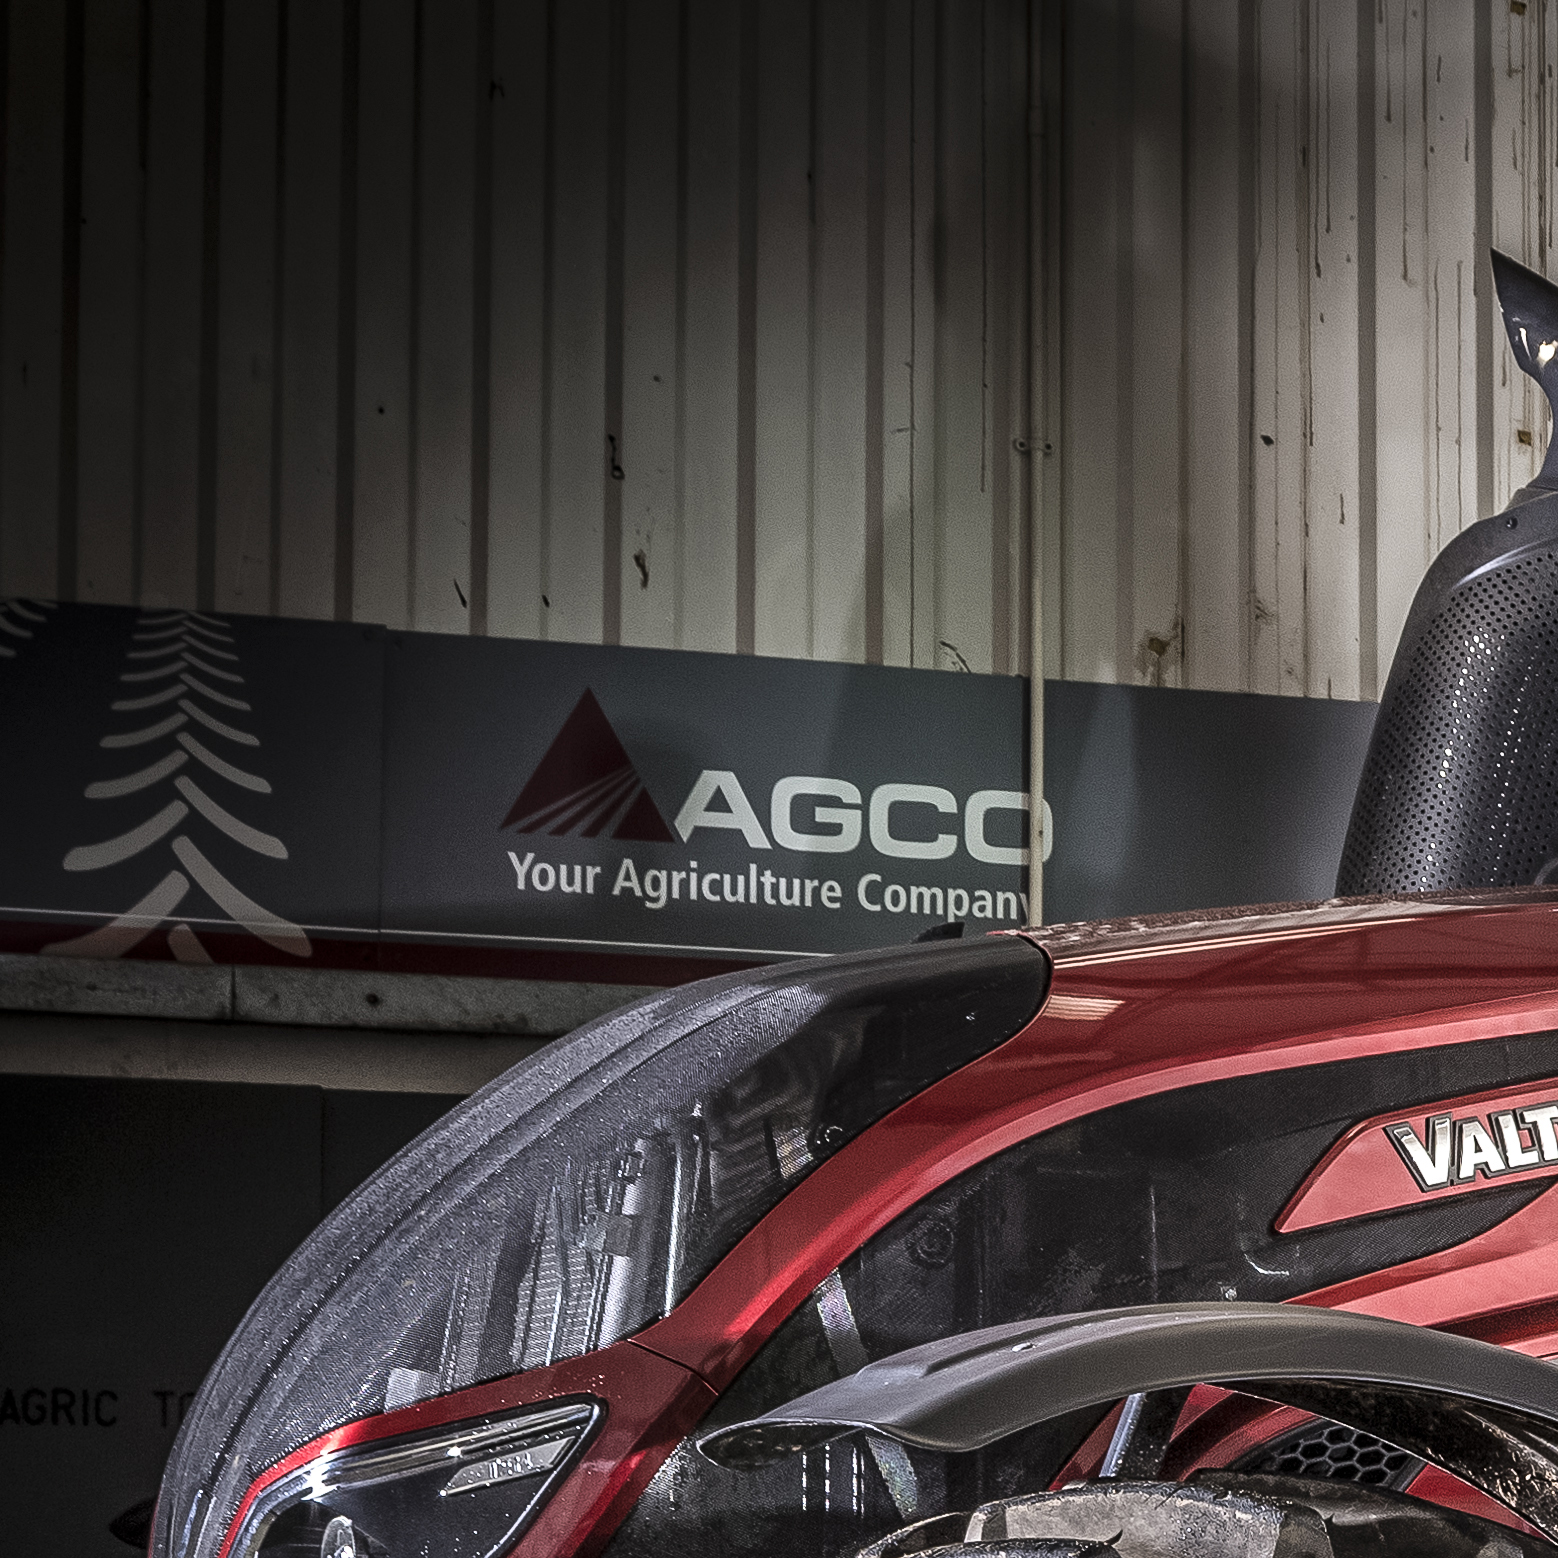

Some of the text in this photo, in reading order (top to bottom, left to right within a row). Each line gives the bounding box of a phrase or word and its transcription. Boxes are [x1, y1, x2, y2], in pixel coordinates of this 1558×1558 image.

[673, 770, 1053, 866] AGCO
[507, 850, 601, 895] Your
[612, 858, 843, 911] Agriculture
[0, 1386, 117, 1427] AGRIC
